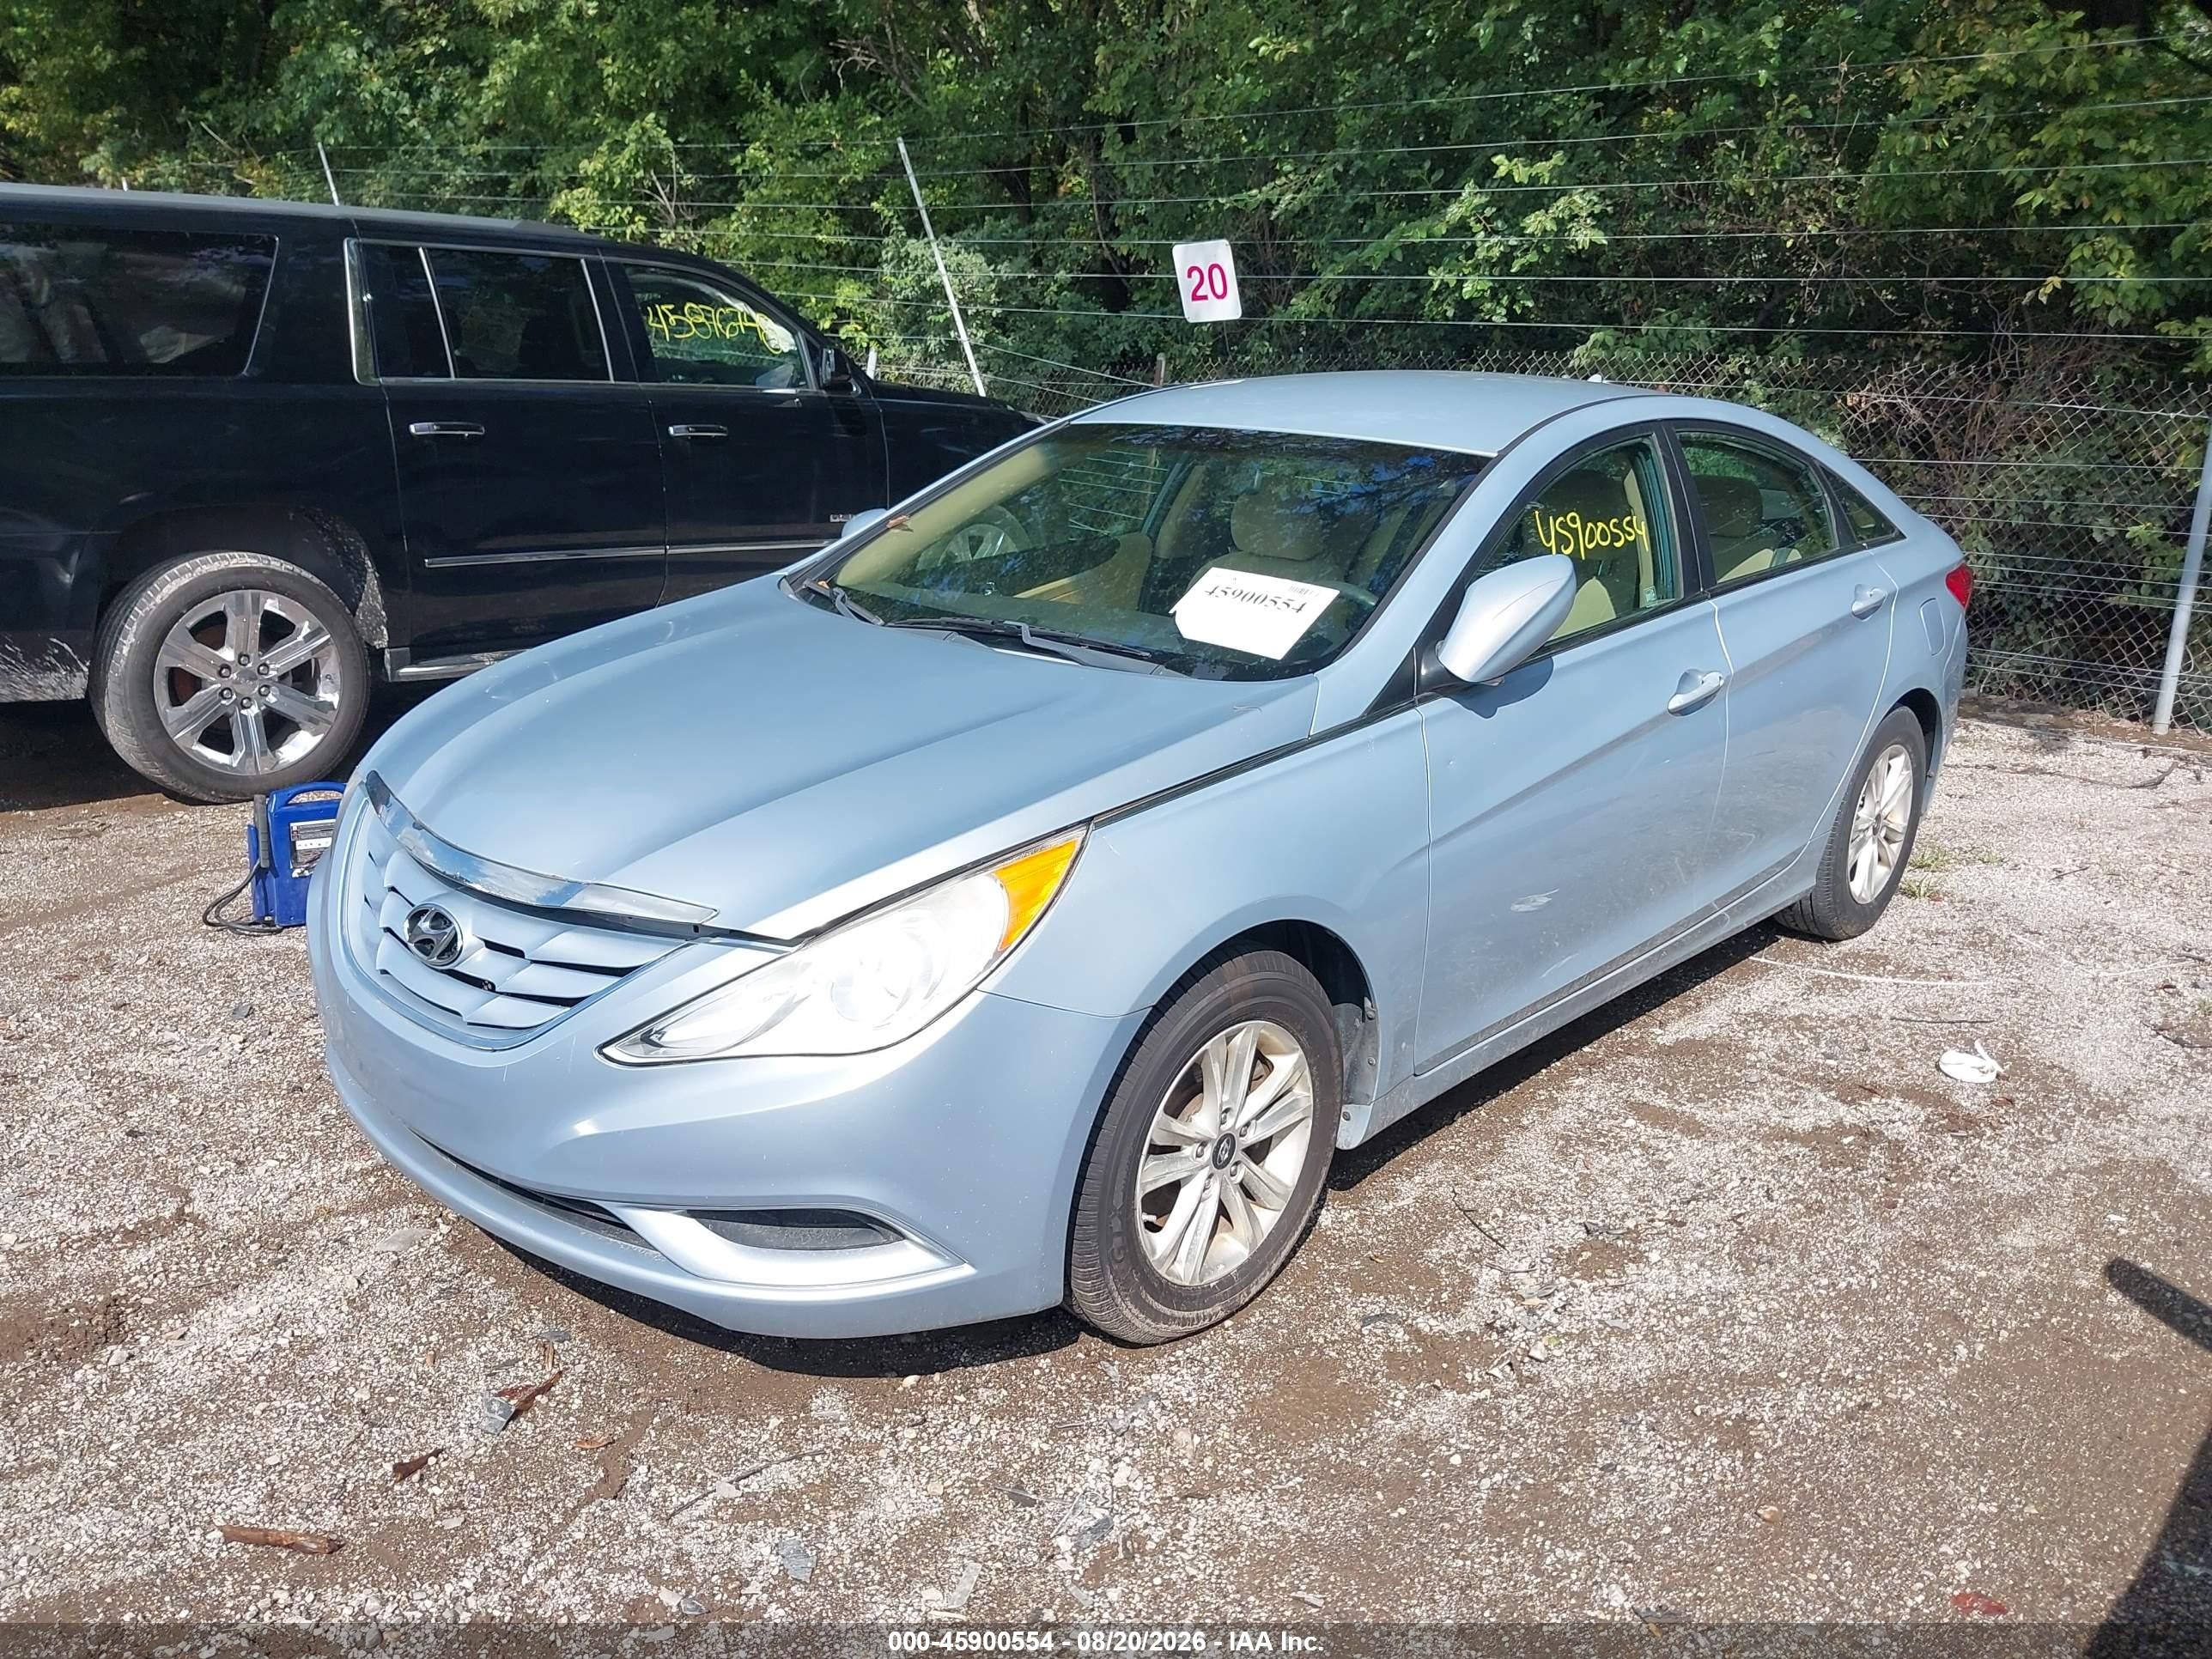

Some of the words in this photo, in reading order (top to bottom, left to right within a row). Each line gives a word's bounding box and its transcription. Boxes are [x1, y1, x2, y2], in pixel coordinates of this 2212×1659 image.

[1186, 263, 1228, 302] 20
[1534, 509, 1650, 561] 45900554
[1204, 585, 1308, 614] 45900554
